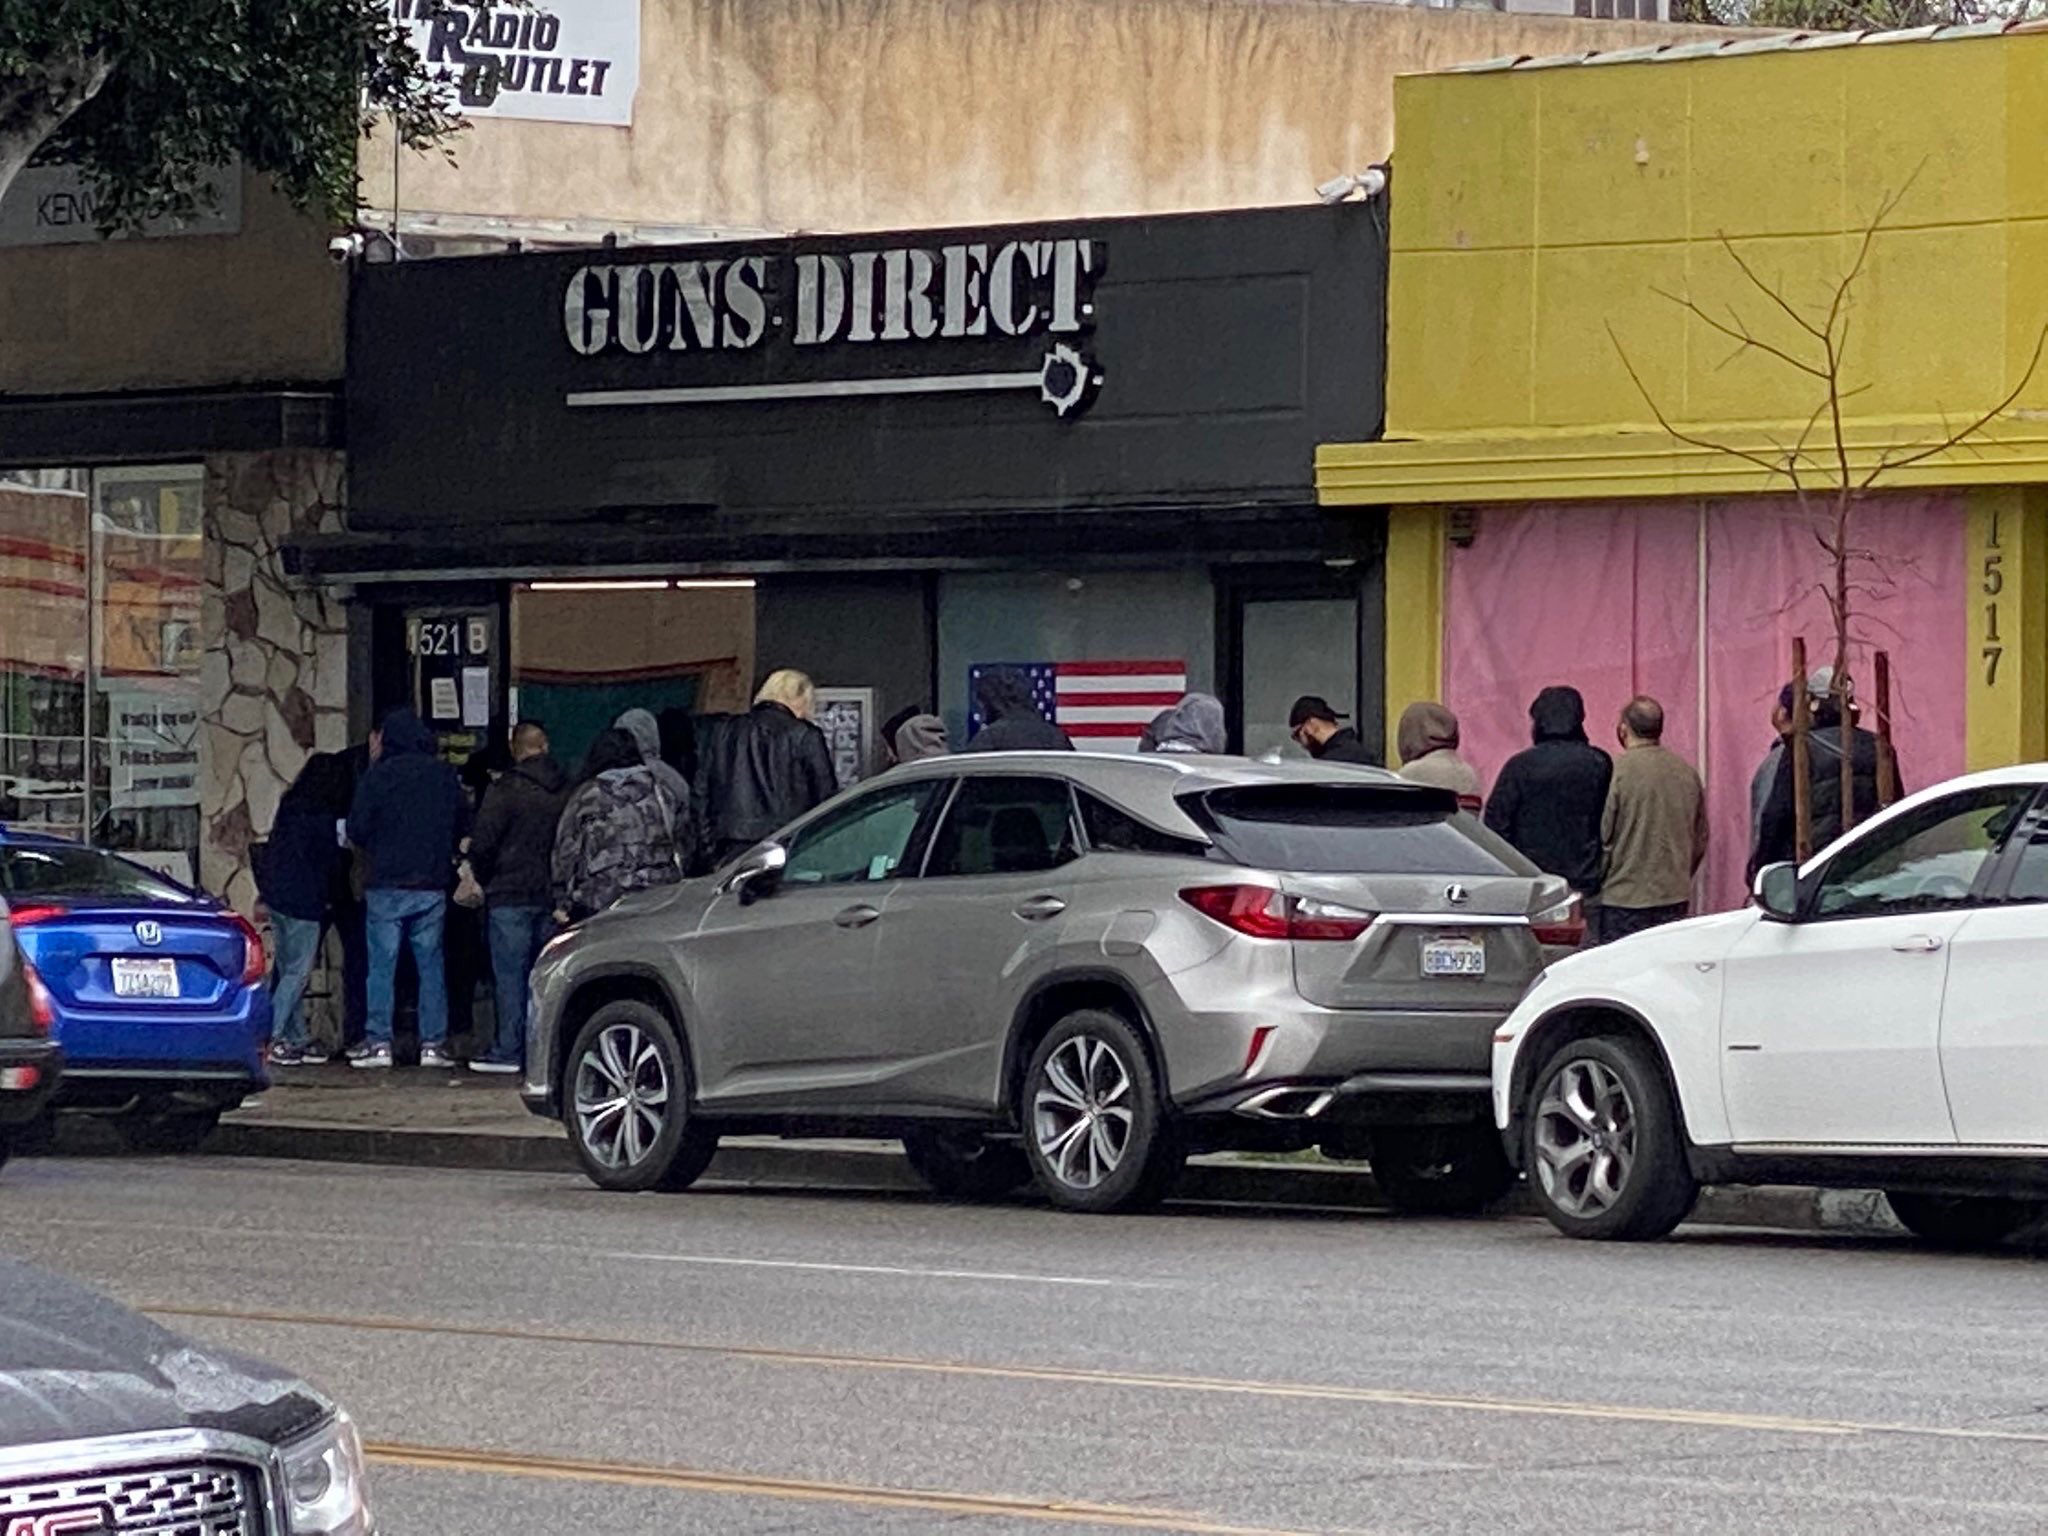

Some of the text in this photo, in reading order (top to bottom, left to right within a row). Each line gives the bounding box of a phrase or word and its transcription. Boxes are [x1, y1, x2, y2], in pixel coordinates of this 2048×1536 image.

[426, 9, 561, 63] RADIO
[459, 52, 612, 107] OUTLET
[564, 239, 1092, 354] GUNS DIRECT
[1982, 510, 2004, 686] 1517
[408, 622, 488, 656] 1521 B
